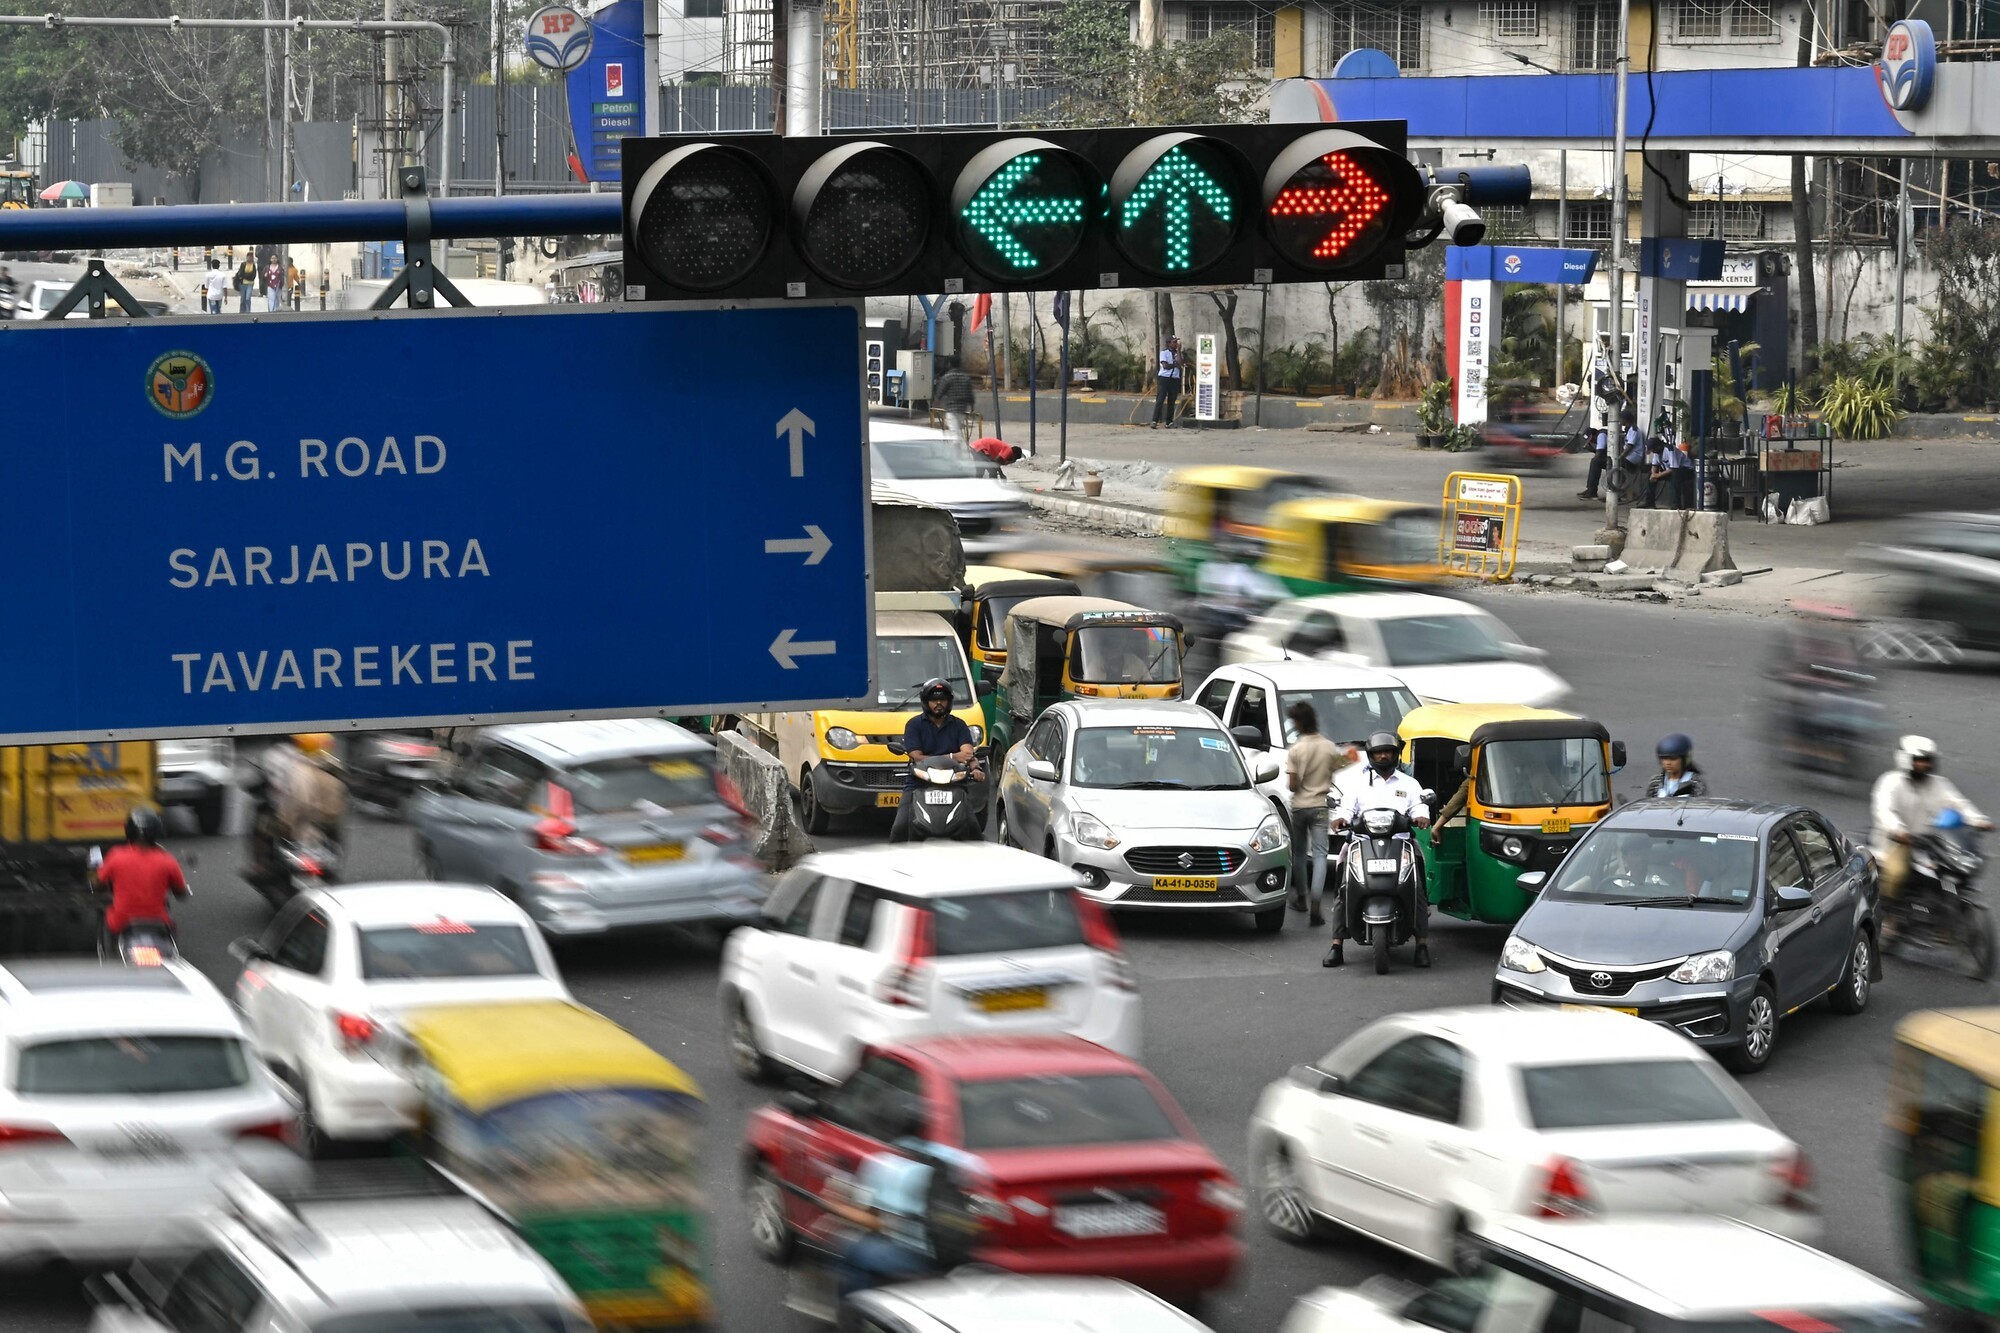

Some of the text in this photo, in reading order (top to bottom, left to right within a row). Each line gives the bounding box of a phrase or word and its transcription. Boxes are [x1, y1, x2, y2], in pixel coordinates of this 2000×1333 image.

[541, 14, 575, 34] HP
[1888, 35, 1909, 60] HP
[602, 104, 632, 113] Petrol
[601, 118, 631, 127] Diesel
[1563, 262, 1586, 271] Diesel
[163, 435, 447, 482] M.G. ROAD
[168, 538, 491, 588] SARJAPURA
[171, 640, 536, 693] TAVAREKERE
[1155, 878, 1215, 889] KA-41-D-0356
